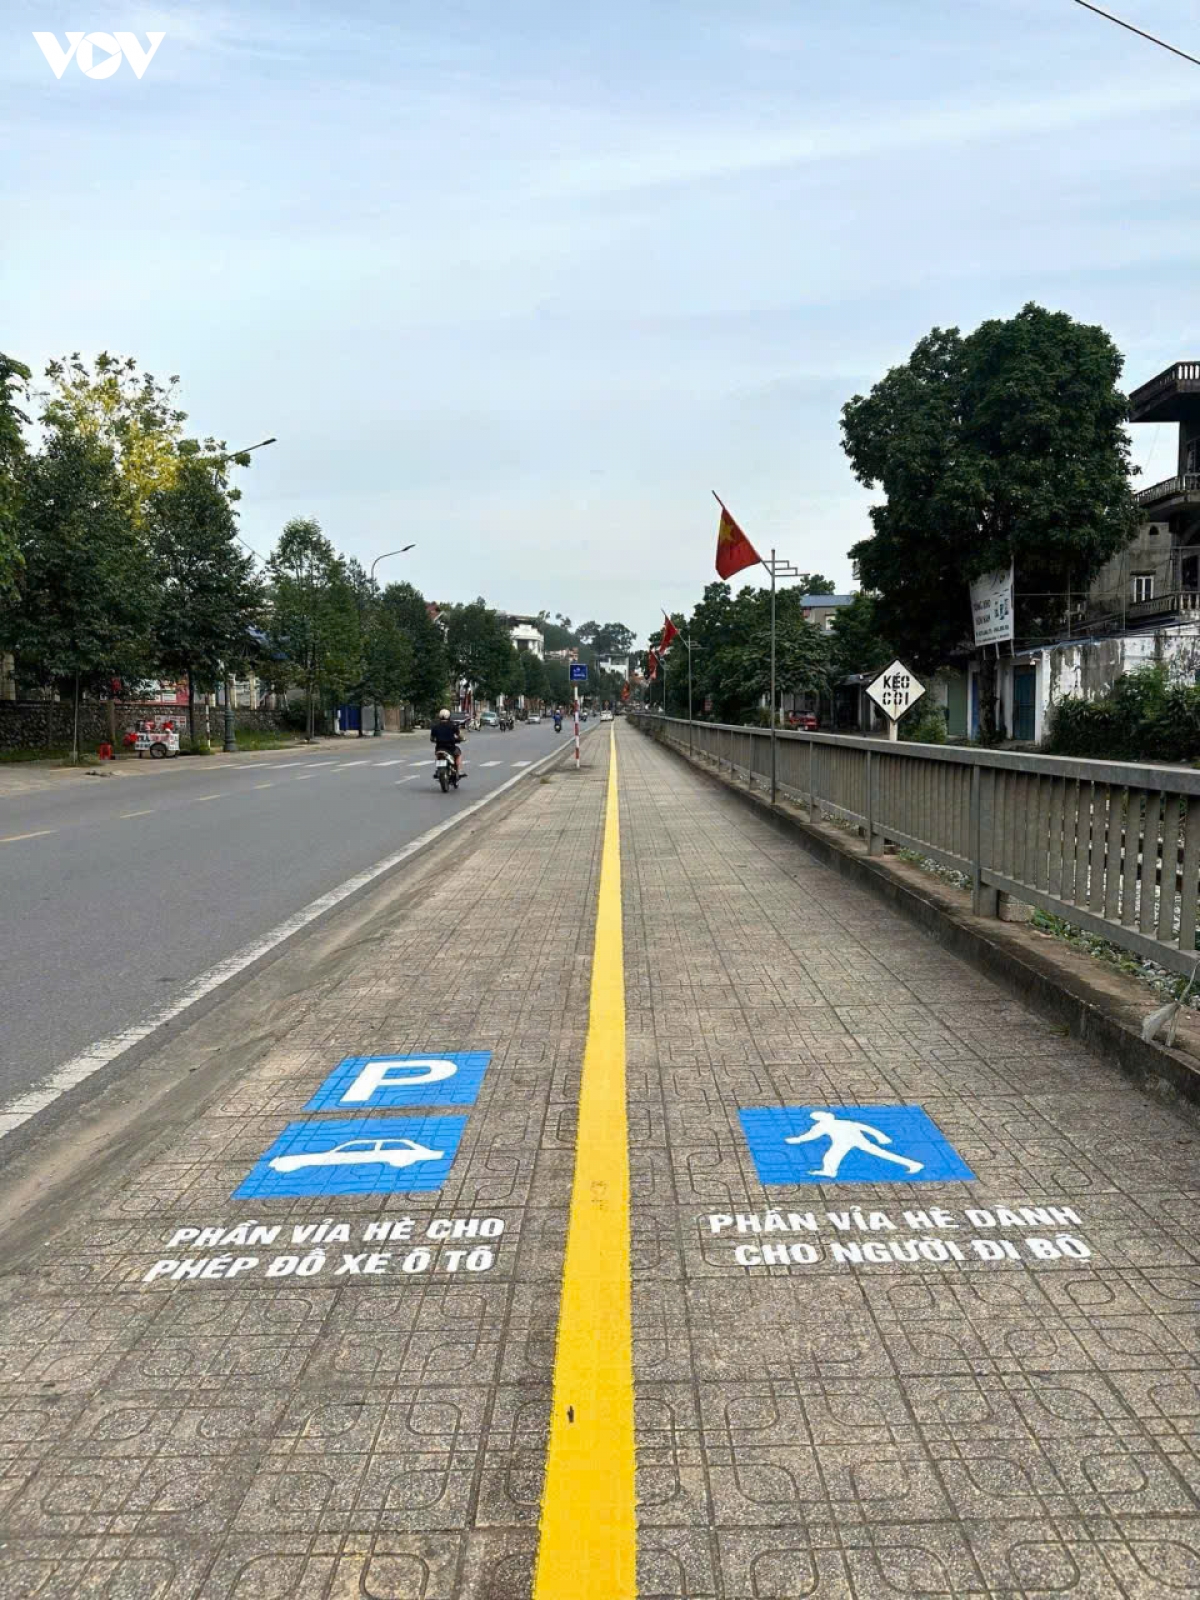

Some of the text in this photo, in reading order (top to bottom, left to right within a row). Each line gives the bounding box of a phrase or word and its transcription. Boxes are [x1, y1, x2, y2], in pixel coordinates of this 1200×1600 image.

[883, 671, 910, 690] KÉO
[340, 1059, 458, 1103] P
[291, 1217, 350, 1243] VỈA
[363, 1216, 415, 1241] HÈ
[426, 1218, 505, 1239] CHO
[827, 1205, 898, 1231] VỈA
[903, 1206, 960, 1230] HÈ
[964, 1204, 1083, 1227] DÀNH
[142, 1252, 259, 1282] PHÉP
[334, 1252, 391, 1275] XE
[402, 1247, 431, 1274] Ô
[445, 1245, 495, 1272] TÔ
[734, 1233, 1092, 1266] CHO NGƯỜI ĐI BỘ
